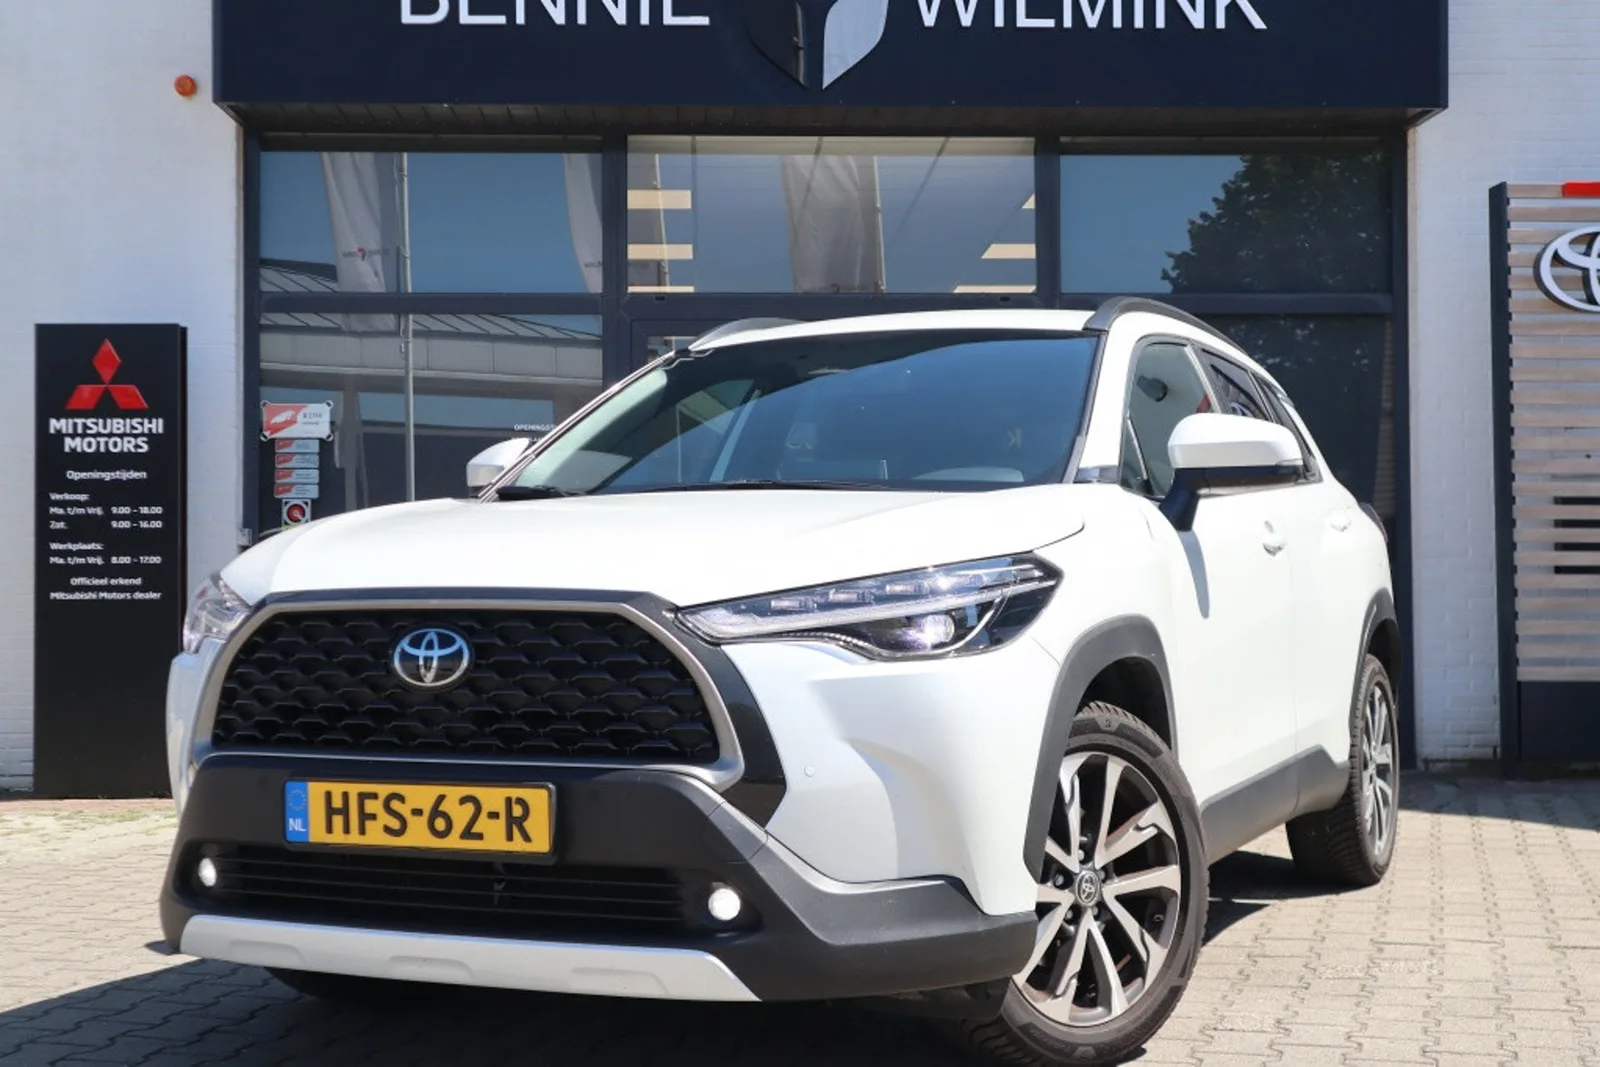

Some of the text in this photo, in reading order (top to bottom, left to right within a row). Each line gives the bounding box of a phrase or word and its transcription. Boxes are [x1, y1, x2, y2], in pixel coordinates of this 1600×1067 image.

[49, 418, 164, 434] MITSUBISHI
[64, 437, 149, 453] MOTORS
[66, 469, 148, 482] Openingstijden
[67, 506, 86, 516] t/m
[110, 506, 131, 515] 9.00
[110, 520, 131, 529] 9.00
[67, 556, 86, 566] t/m
[110, 556, 131, 565] 8.00
[70, 576, 142, 586] Officieel erkend
[49, 591, 161, 601] Mitsubishi Motors dealer
[324, 789, 532, 843] HFS-62-R
[288, 817, 306, 832] NL
